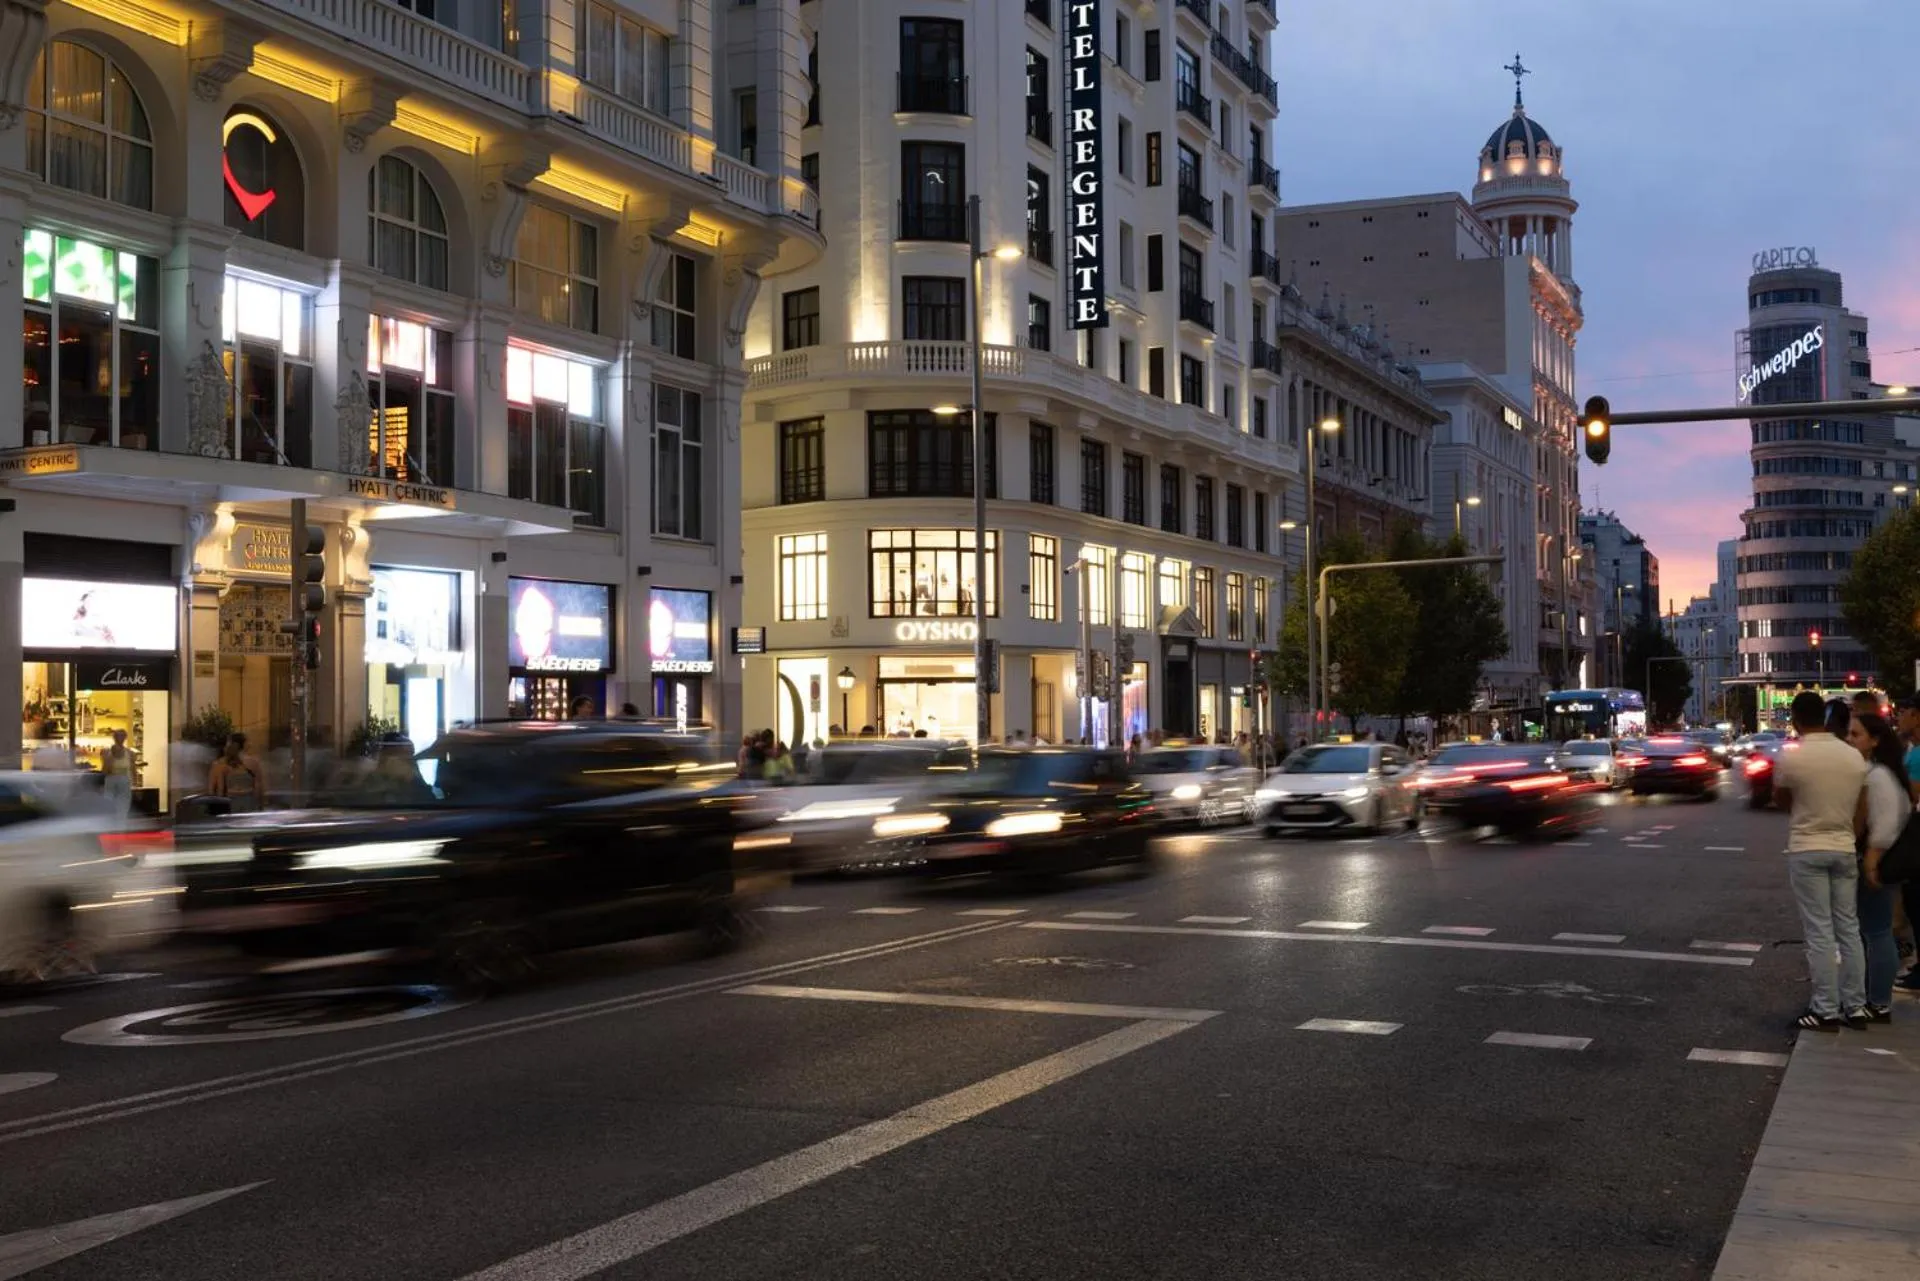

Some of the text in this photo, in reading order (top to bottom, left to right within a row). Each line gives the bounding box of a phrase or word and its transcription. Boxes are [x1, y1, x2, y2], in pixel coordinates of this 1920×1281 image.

[1072, 2, 1099, 323] TEL REGENTE
[1752, 246, 1819, 269] CAPITOL
[1739, 324, 1825, 401] Schweppes
[30, 454, 74, 468] CENTRIC
[348, 478, 448, 504] HYATT CENTRIC
[896, 621, 978, 641] OYSHO
[526, 655, 602, 672] SKECHERS
[651, 660, 714, 673] SKECHERS
[100, 668, 148, 685] Clarks
